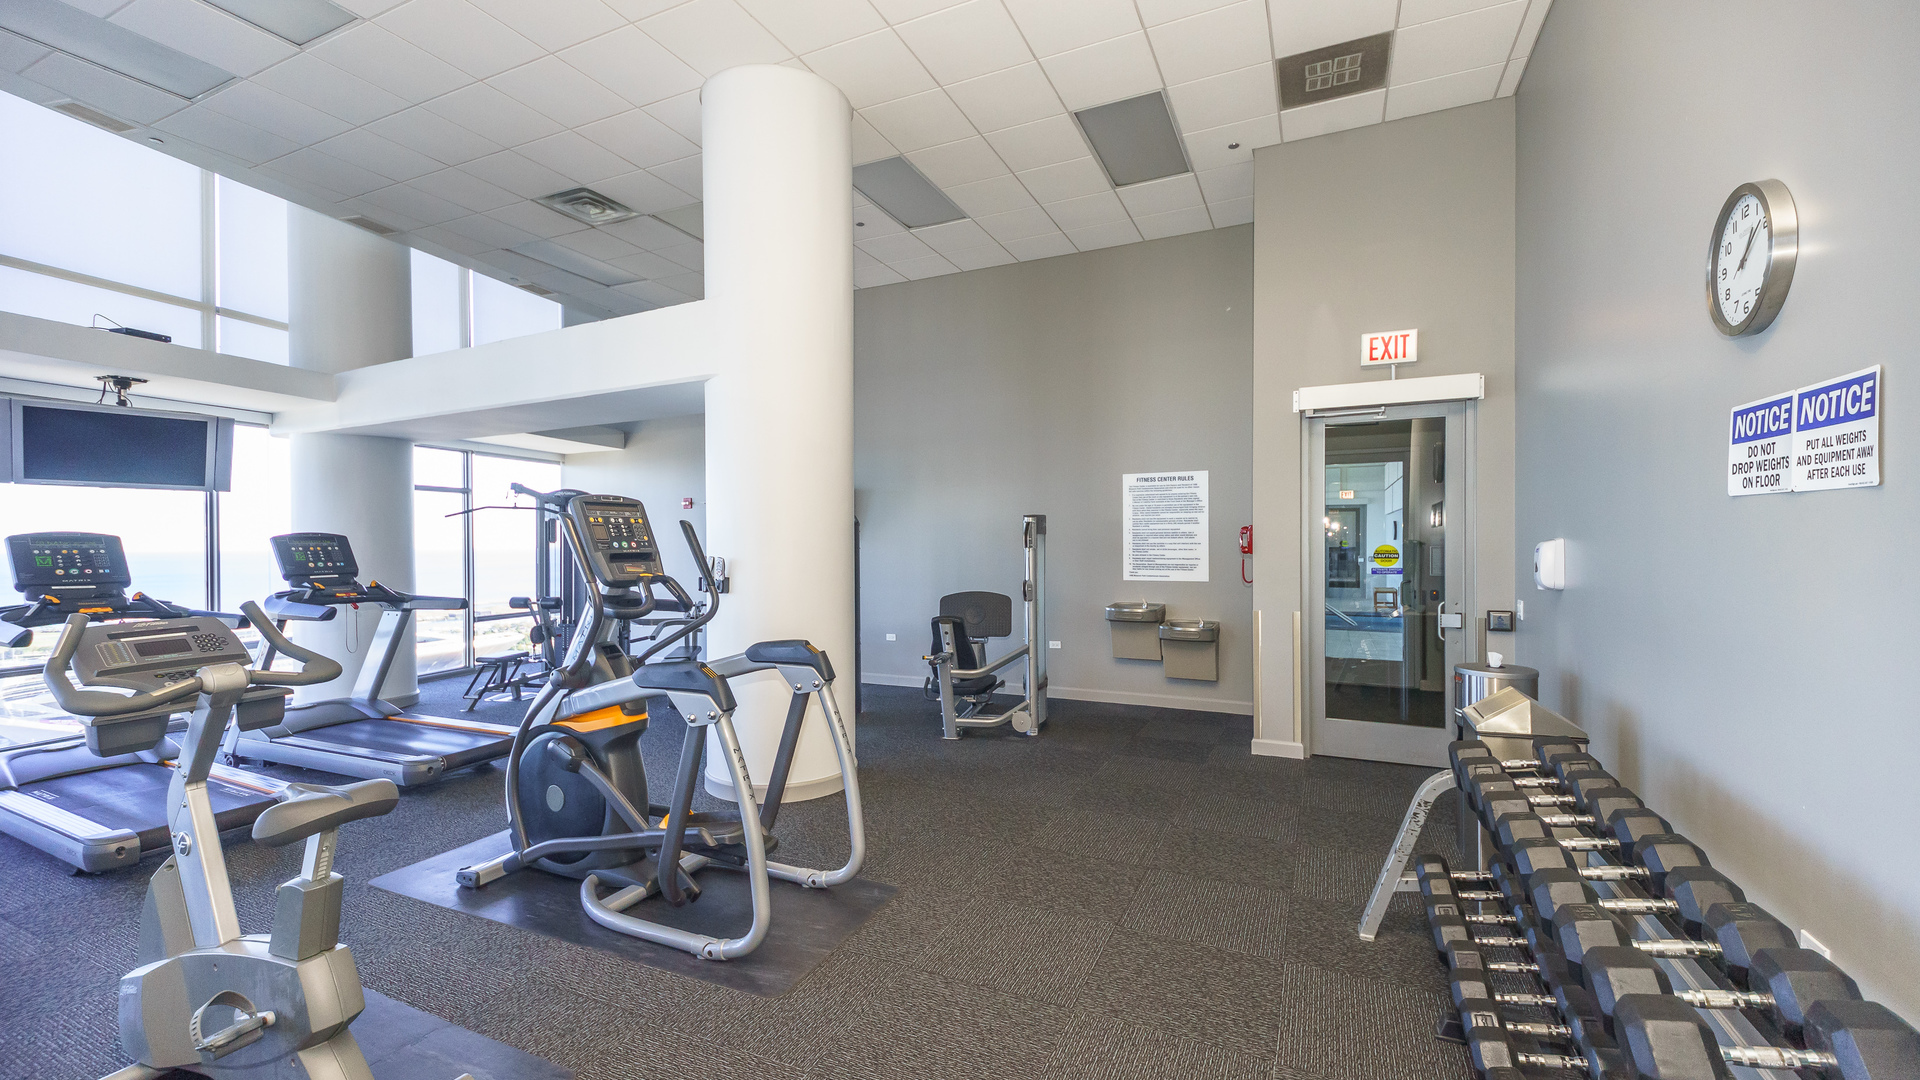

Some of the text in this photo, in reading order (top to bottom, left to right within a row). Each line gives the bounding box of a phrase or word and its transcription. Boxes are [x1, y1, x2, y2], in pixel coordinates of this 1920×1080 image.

[1741, 203, 1750, 220] 12
[1755, 202, 1759, 216] 1
[1732, 220, 1738, 234] 11
[1762, 215, 1768, 229] 2
[1724, 242, 1732, 257] 10
[1721, 268, 1728, 281] 9
[1725, 288, 1731, 301] 8
[1733, 300, 1739, 313] 7
[1743, 301, 1749, 314] 6
[1369, 334, 1410, 361] EXIT
[1800, 379, 1874, 426] NOTICE
[1734, 402, 1791, 439] NOTICE
[1806, 429, 1867, 451] PUT ALL WEIGHTS
[1747, 442, 1776, 458] DO NOT
[1796, 444, 1875, 467] AND EQUIPMENT AWAY
[1731, 455, 1790, 475] DROP WEIGHTS
[1806, 463, 1866, 481] AFTER EACH USE
[1742, 473, 1781, 489] ON FLOOR
[1341, 491, 1352, 499] EXIT
[733, 747, 756, 800] MATRIX
